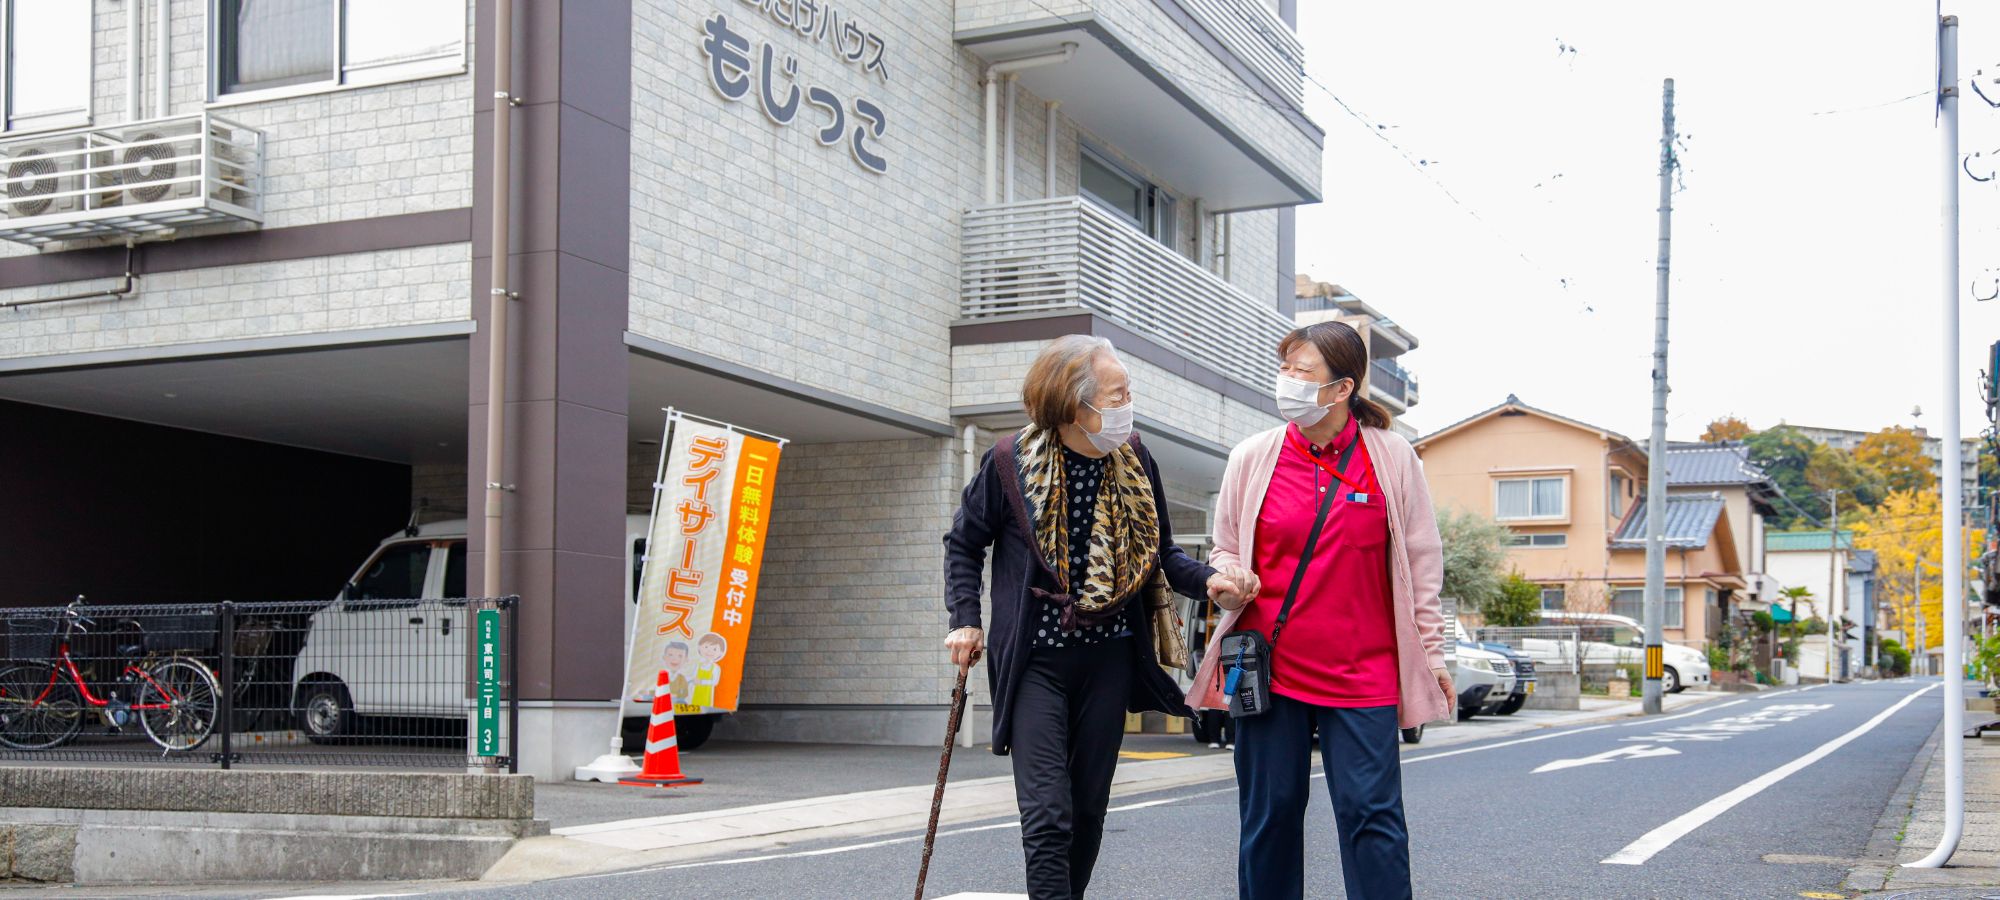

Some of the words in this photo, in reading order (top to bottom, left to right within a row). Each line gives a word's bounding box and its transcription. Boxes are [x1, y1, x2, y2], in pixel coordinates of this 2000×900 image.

[703, 14, 887, 172] もじっこ
[656, 434, 728, 640] デイサービス
[734, 452, 768, 566] 一日無料体験
[722, 567, 749, 627] 受付中
[483, 643, 493, 719] 東門司二丁目
